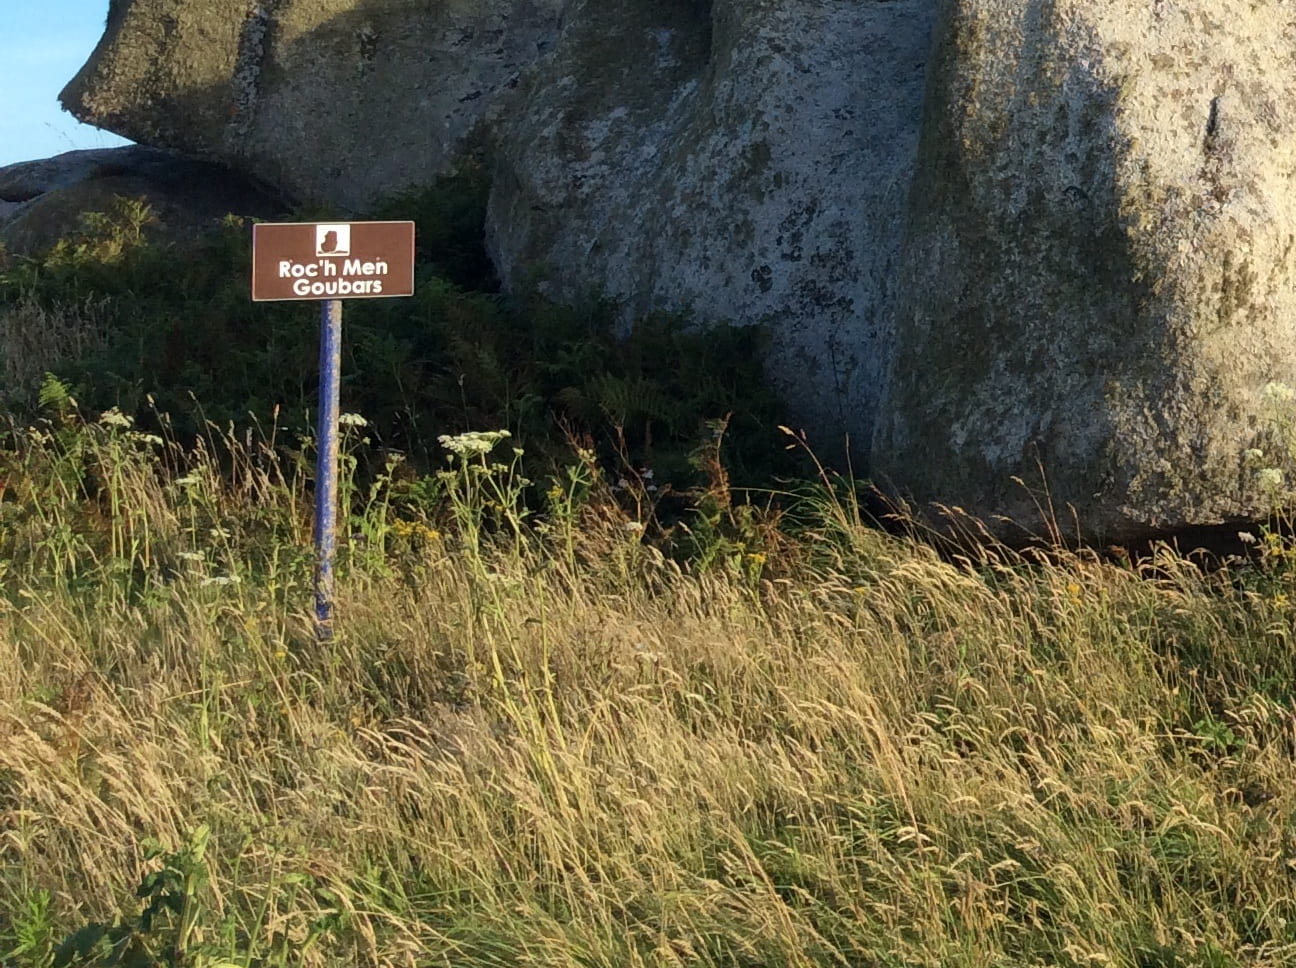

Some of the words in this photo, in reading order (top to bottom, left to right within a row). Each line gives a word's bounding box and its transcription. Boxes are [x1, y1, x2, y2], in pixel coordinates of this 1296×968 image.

[279, 259, 337, 278] Roc'h
[342, 259, 388, 275] Men
[293, 278, 382, 296] Goubars
